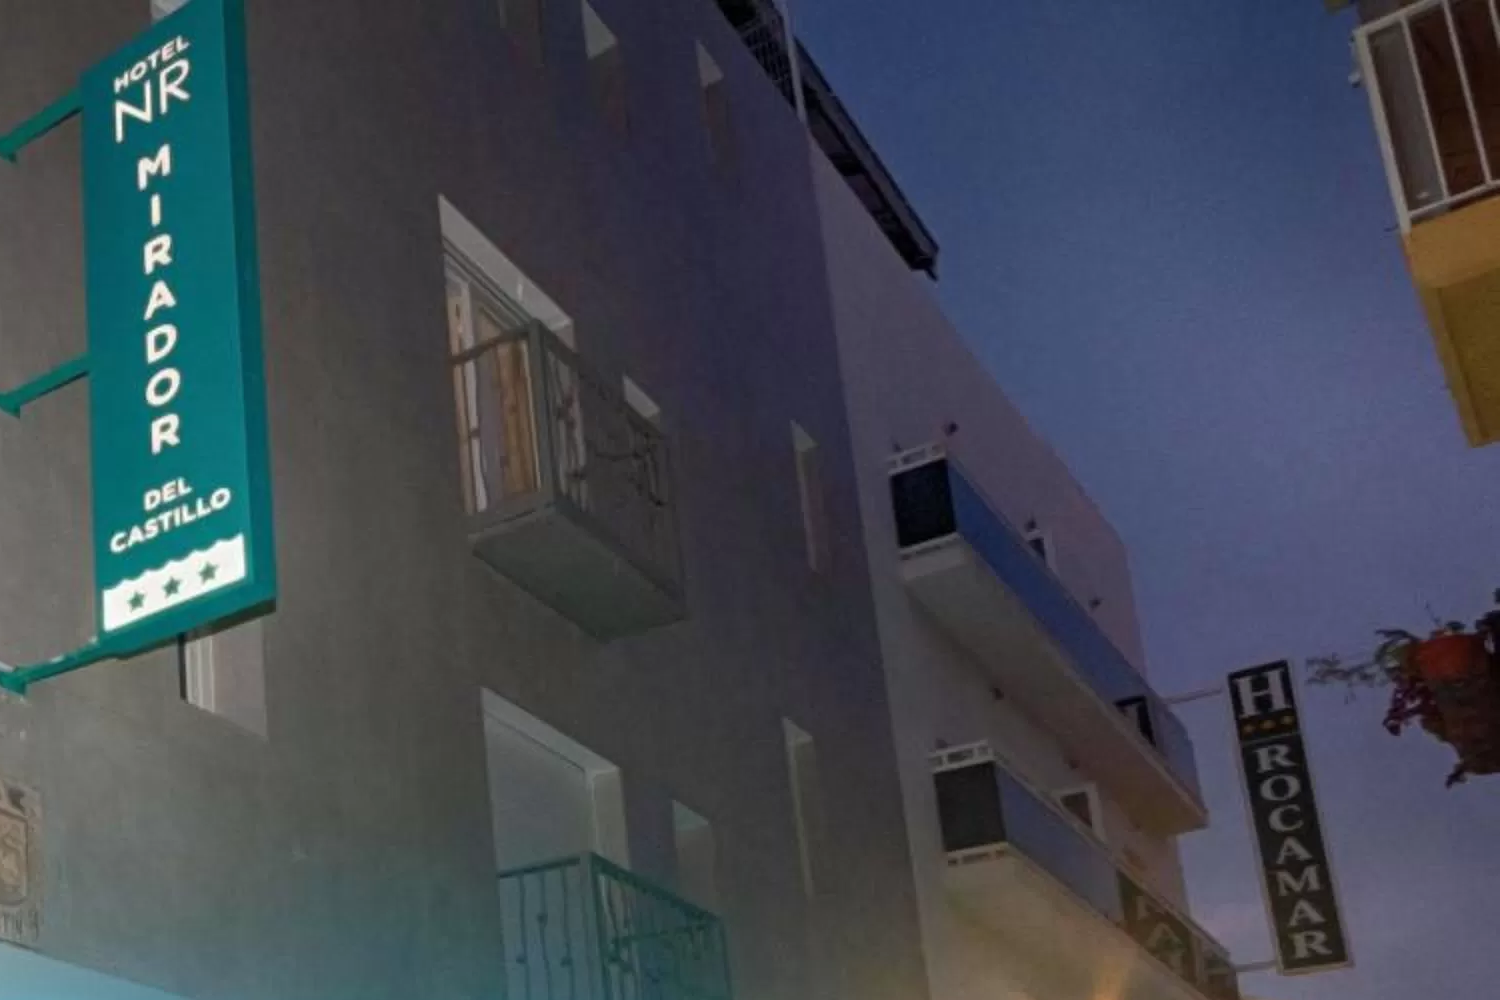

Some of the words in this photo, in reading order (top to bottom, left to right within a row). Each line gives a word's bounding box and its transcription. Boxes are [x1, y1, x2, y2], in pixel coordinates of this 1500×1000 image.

[113, 35, 190, 93] HOTEL
[114, 59, 190, 143] NR
[136, 143, 181, 455] MIRADOR
[109, 486, 232, 554] CASTILLO
[143, 477, 192, 511] DEL
[1234, 668, 1294, 718] H
[1254, 743, 1333, 960] ROCAMAR
